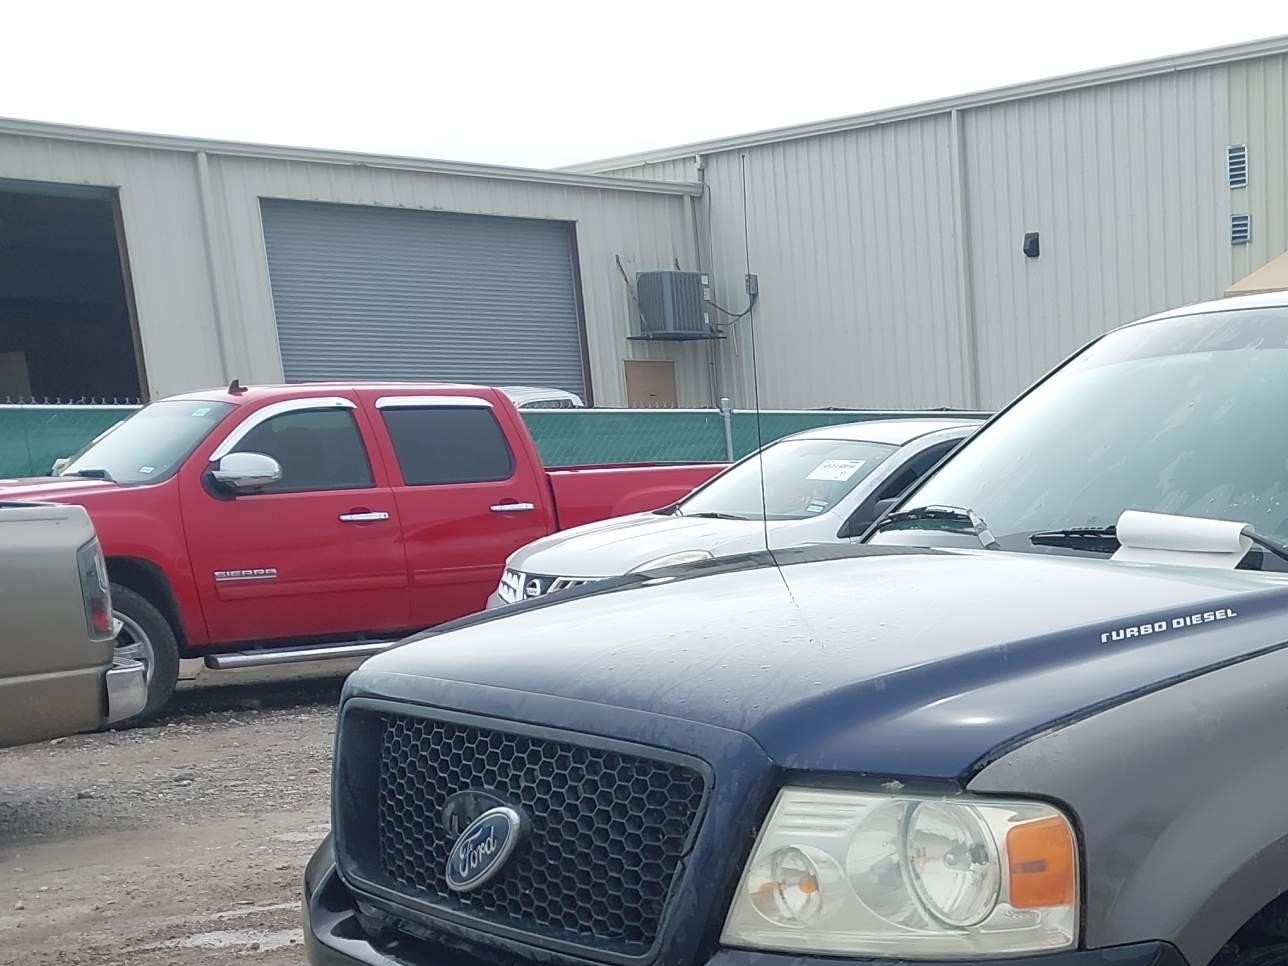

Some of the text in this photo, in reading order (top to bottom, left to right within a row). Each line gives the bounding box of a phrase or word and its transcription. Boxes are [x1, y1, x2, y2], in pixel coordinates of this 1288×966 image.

[214, 568, 277, 578] SIERRA
[1101, 608, 1238, 644] TURBO DIESEL
[459, 823, 497, 878] Ford
